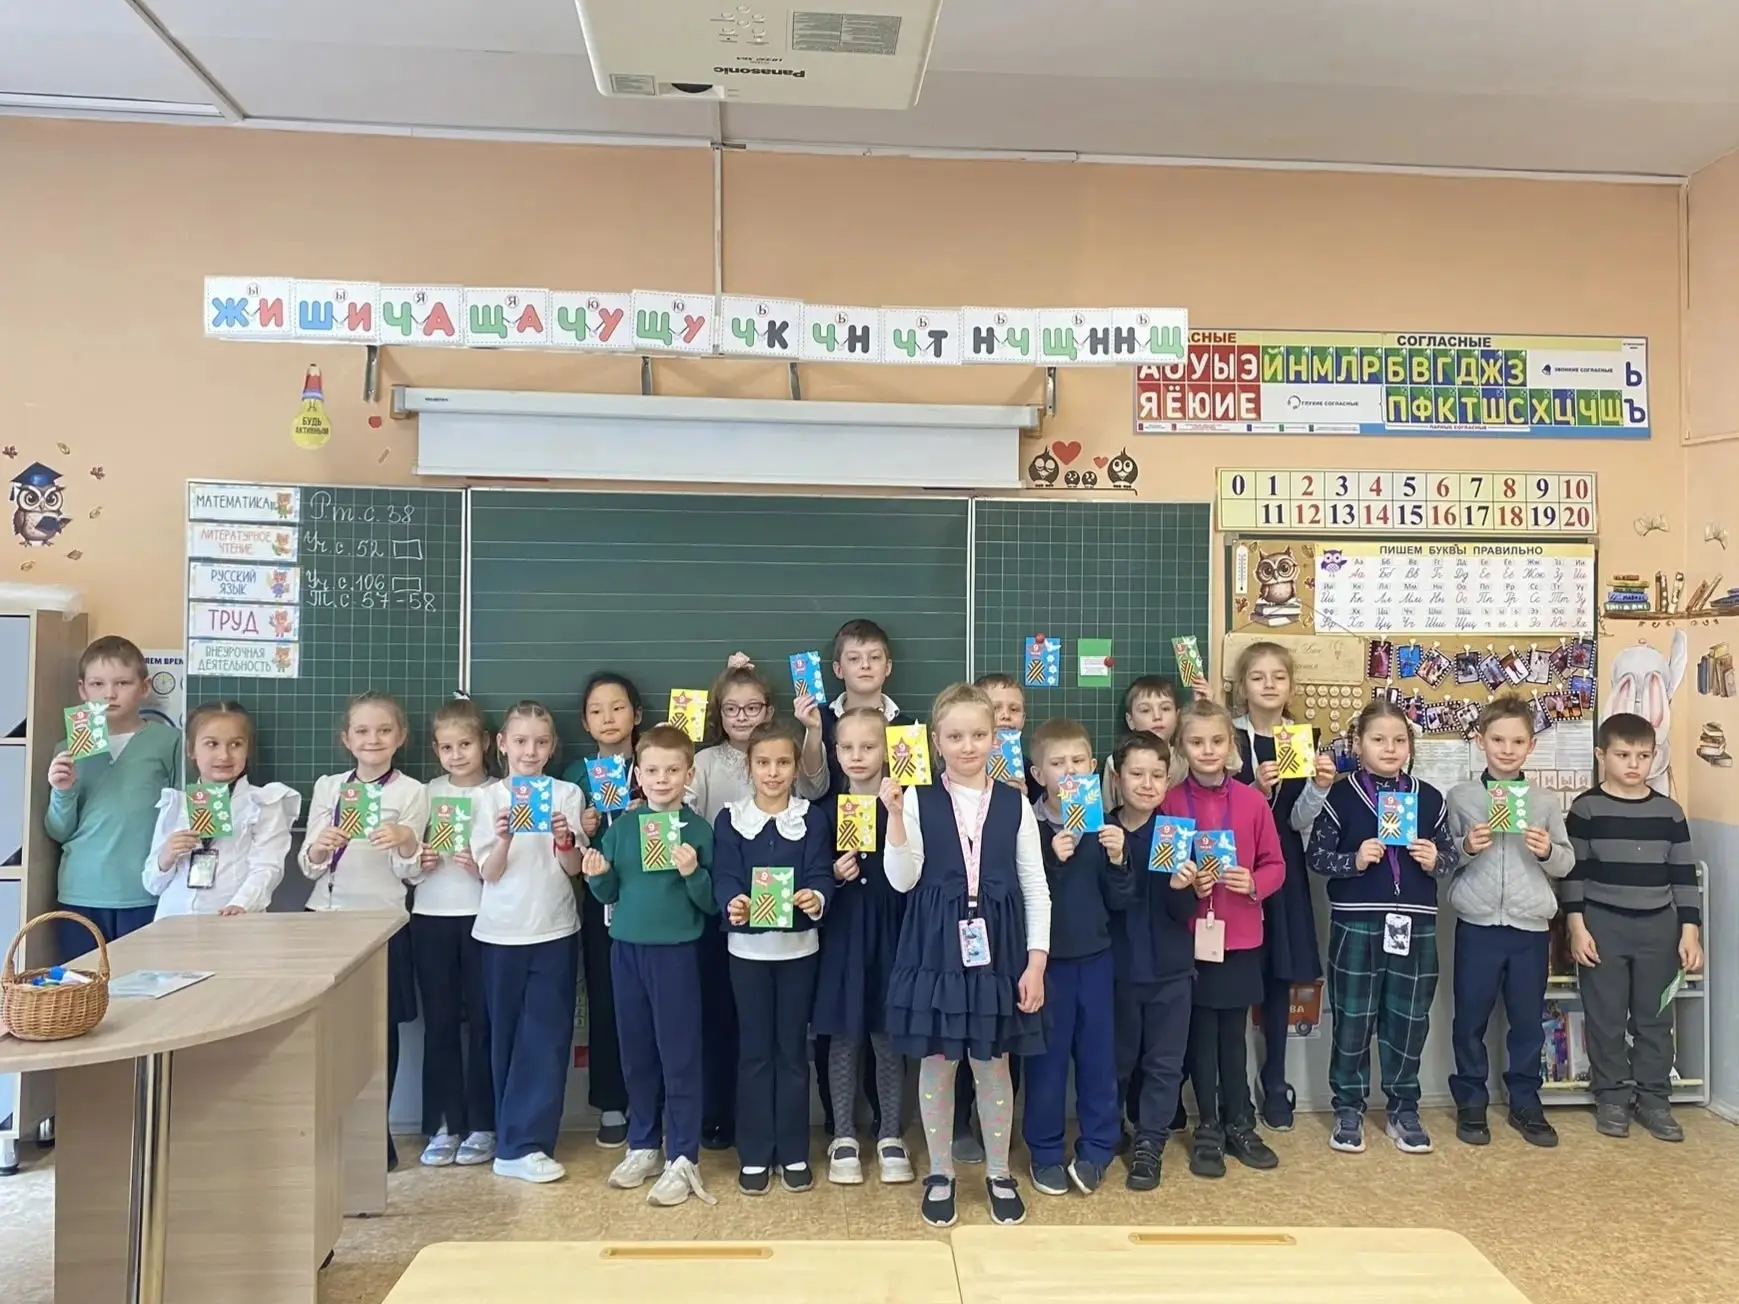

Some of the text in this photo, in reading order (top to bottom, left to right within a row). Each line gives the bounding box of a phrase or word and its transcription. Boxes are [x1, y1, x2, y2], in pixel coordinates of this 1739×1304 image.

[713, 65, 805, 78] Panasonic
[1188, 332, 1237, 343] СНЫЕ
[1397, 335, 1491, 348] СОГЛАСНЫЕ
[302, 416, 322, 426] БУДЬ
[1232, 474, 1588, 500] 0 1 2 3 4 5 6 7 8 9 10
[196, 495, 269, 509] МАТЕМАТИКА
[387, 504, 415, 523] 38
[1262, 503, 1590, 528] 11 12 13 14 15 16 17 18 19 20
[201, 528, 271, 543] ЛИТЕРАТУРНОЕ
[219, 542, 253, 555] ЧТЕНИЕ
[356, 539, 384, 558] 52
[1380, 545, 1543, 556] ПИШЕМ БУКВЫ ПРАВИЛЬНО
[211, 568, 257, 583] РУССКИЙ
[219, 582, 247, 595] ЯЗЫК
[356, 573, 386, 592] 106
[208, 609, 259, 635] ТРУД
[205, 646, 265, 658] ВНЕУРОЧНАЯ
[198, 659, 271, 672] ДЕЯТЕЛЬНОСТЬ
